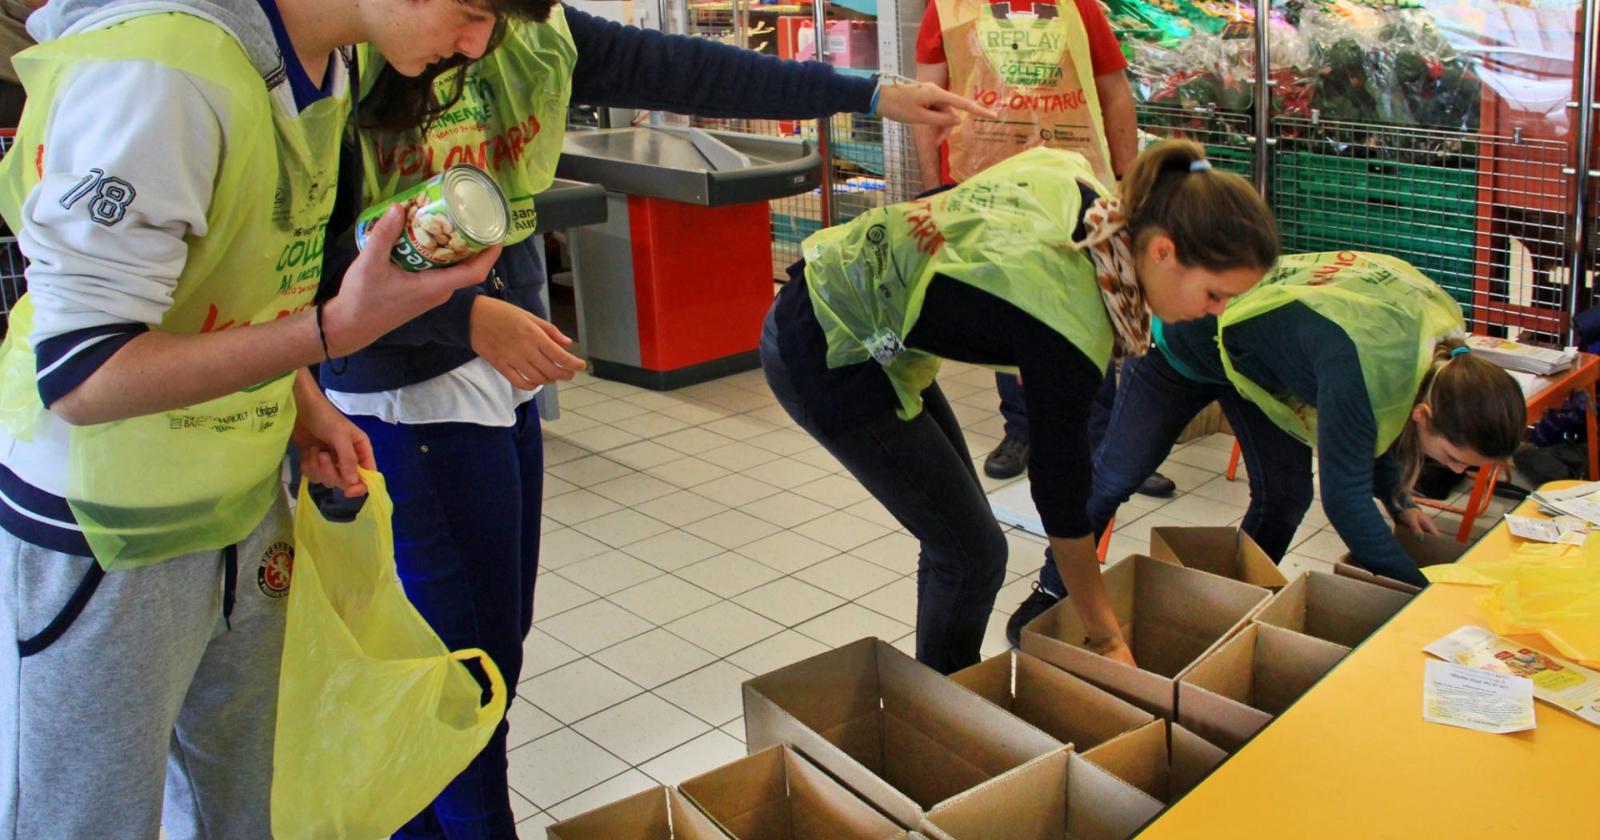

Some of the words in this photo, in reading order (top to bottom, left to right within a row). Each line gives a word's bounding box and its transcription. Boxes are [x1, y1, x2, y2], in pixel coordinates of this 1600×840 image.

[988, 30, 1061, 49] REPLAY
[1000, 63, 1063, 79] COLLETTA
[255, 402, 278, 418] Unipol
